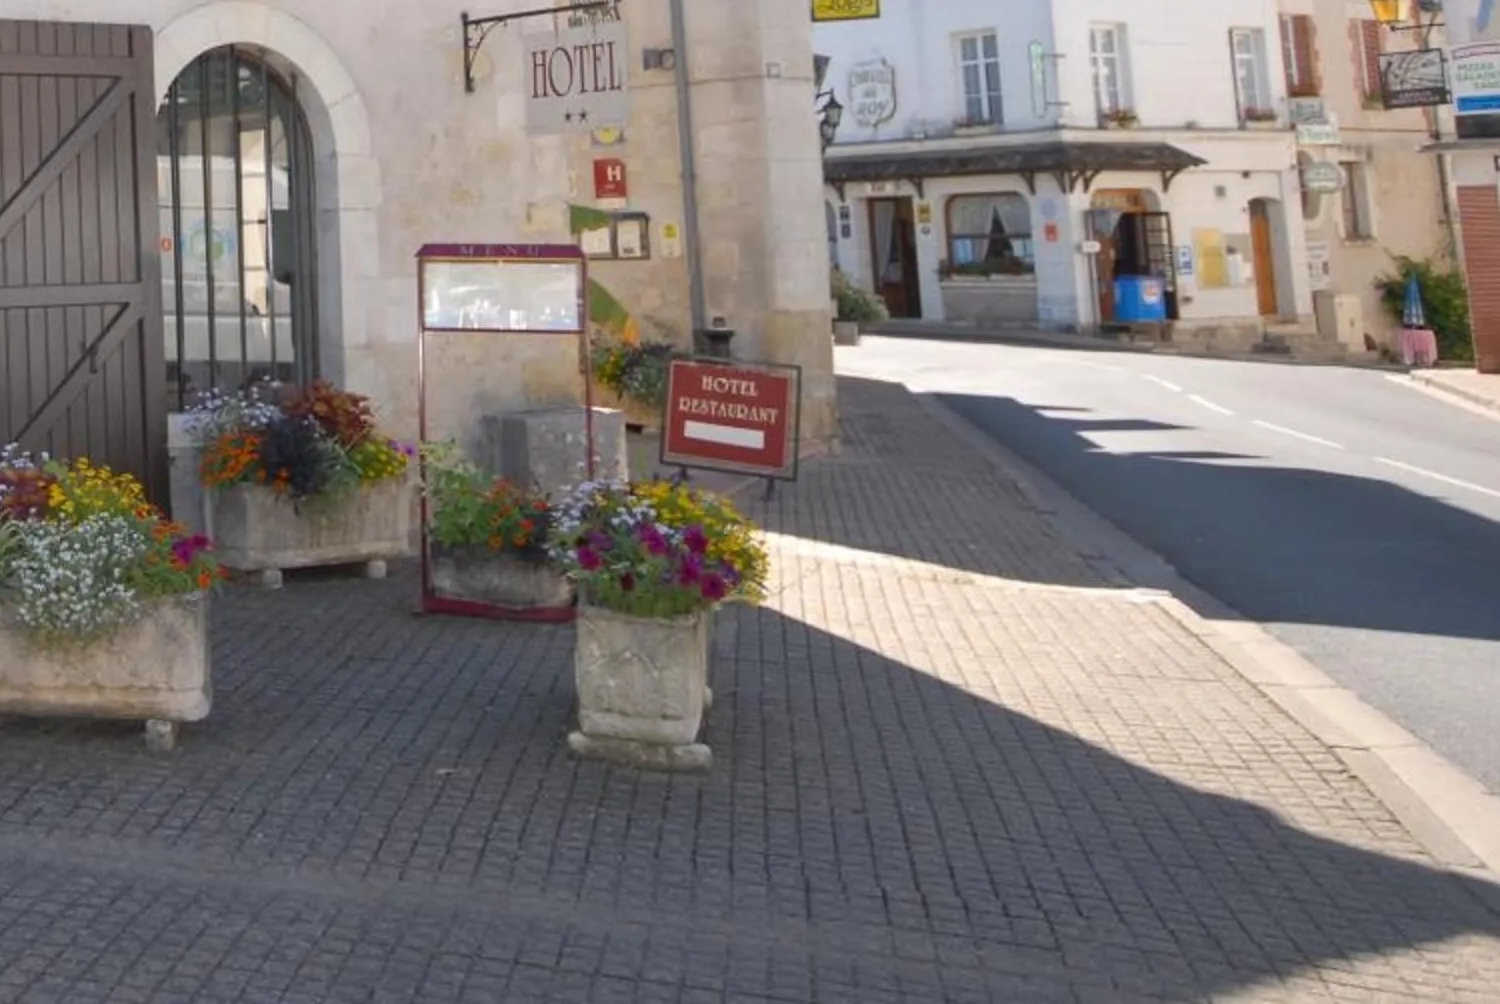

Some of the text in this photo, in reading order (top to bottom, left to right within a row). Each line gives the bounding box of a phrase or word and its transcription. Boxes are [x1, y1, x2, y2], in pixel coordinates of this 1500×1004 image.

[531, 41, 622, 99] HOTEL
[607, 164, 621, 181] H
[701, 375, 759, 397] HOTEL
[678, 396, 779, 425] RESTAURANT
